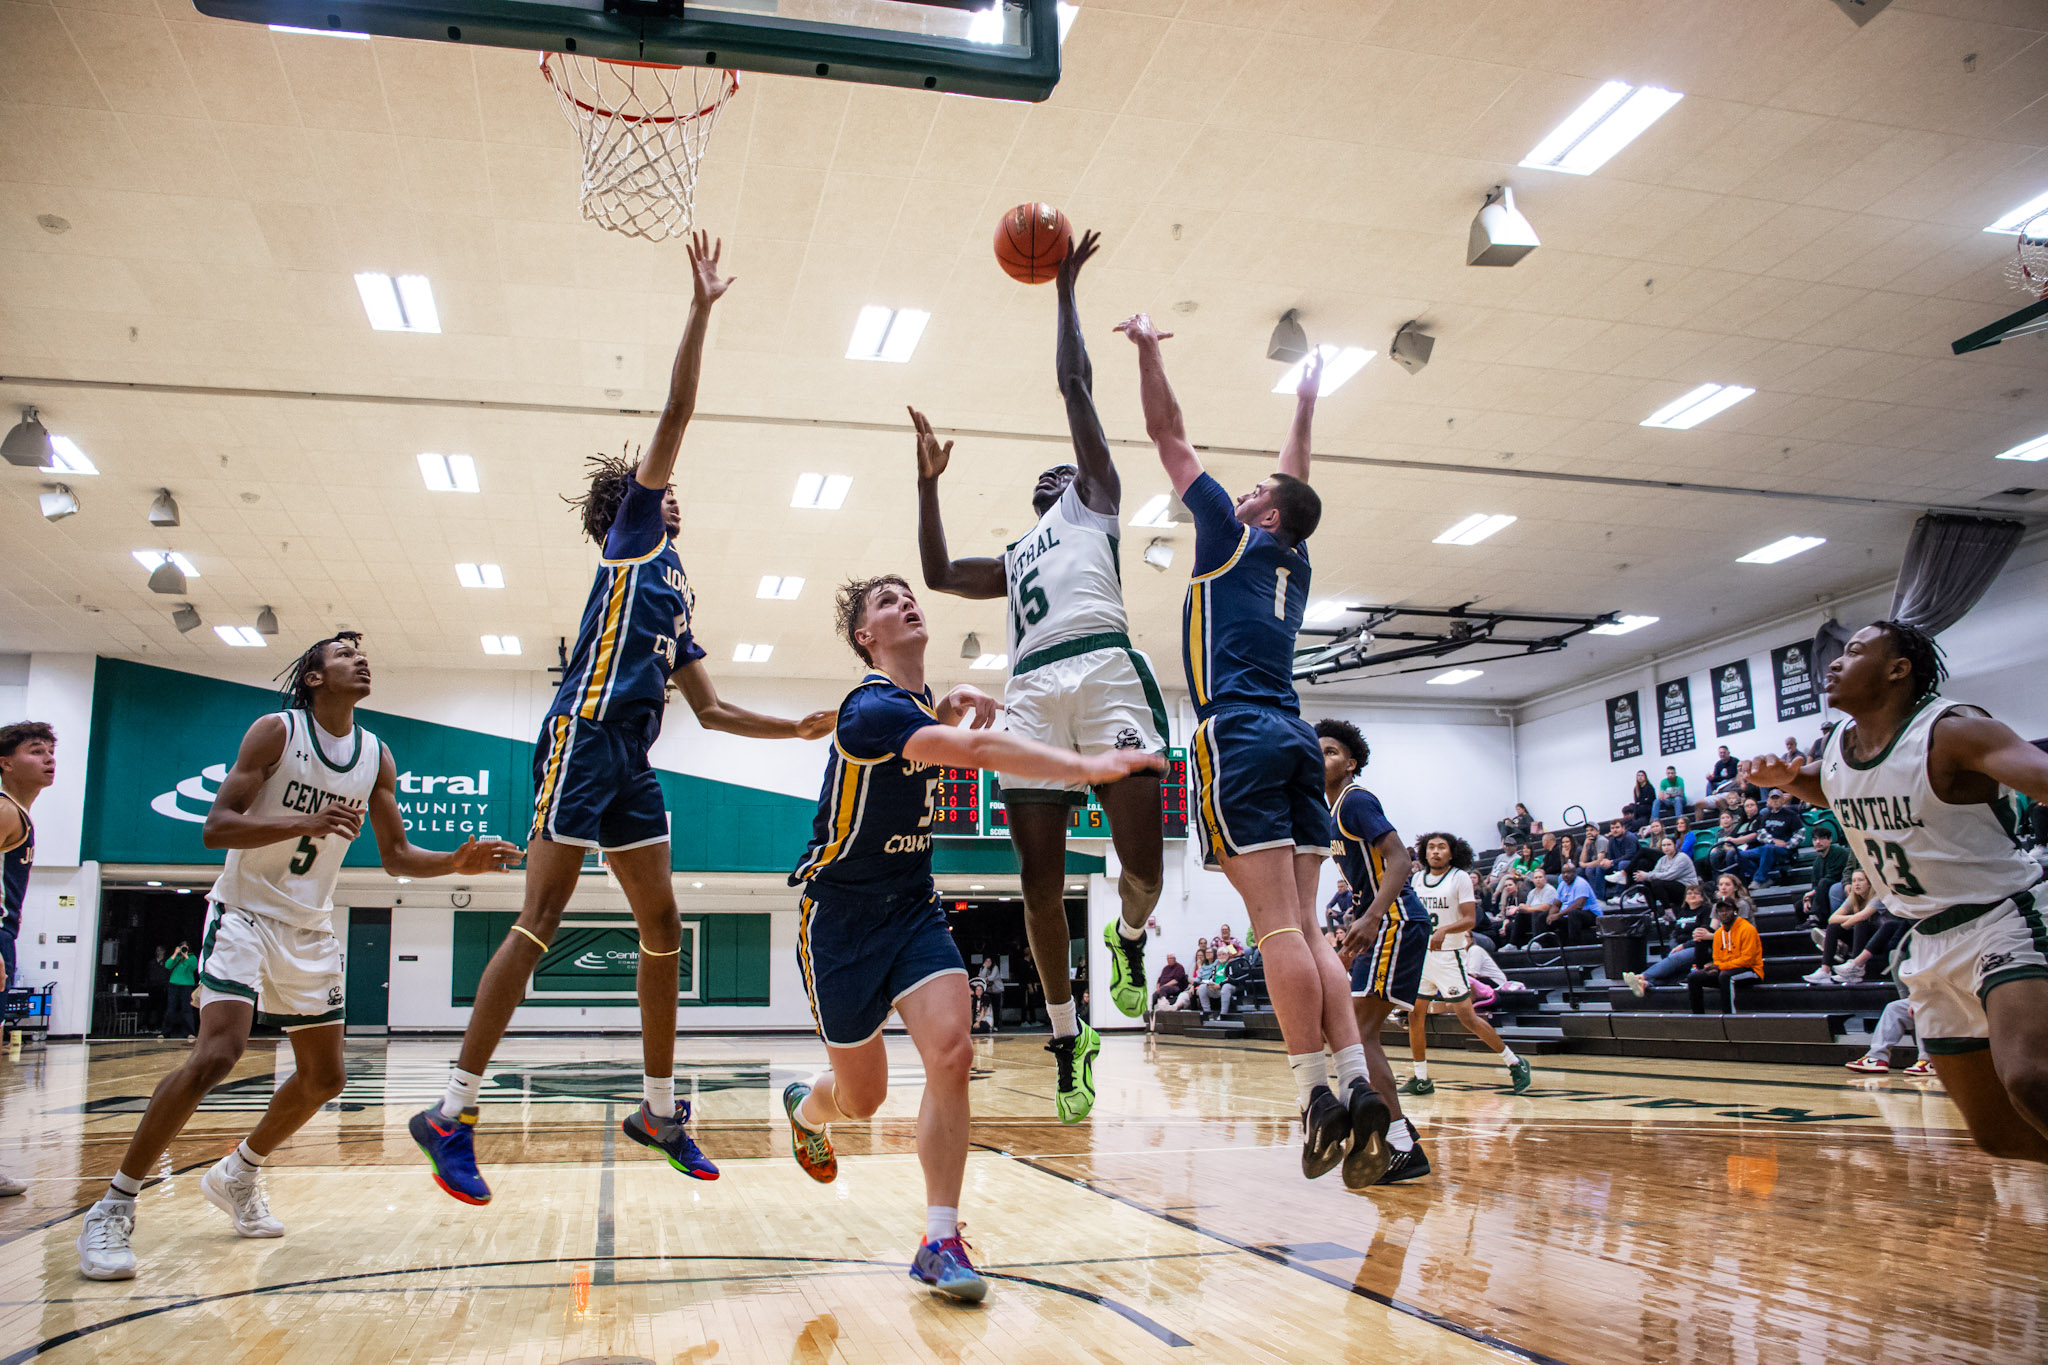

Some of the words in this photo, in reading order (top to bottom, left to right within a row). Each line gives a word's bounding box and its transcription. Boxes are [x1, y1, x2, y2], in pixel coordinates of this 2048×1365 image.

[1274, 566, 1291, 621] 1
[1780, 707, 1796, 717] 1972
[1800, 701, 1817, 712] 1974
[1727, 721, 1743, 731] 2020
[1174, 760, 1186, 773] 13
[949, 768, 957, 780] 0
[965, 770, 978, 780] 14
[396, 770, 489, 795] tral
[938, 782, 945, 794] 5
[969, 783, 978, 795] 2
[397, 802, 488, 815] MUNITY
[949, 796, 957, 808] 0
[969, 796, 978, 808] 0
[949, 809, 957, 822] 0
[969, 809, 978, 822] 0
[1090, 811, 1101, 827] 5
[402, 819, 488, 833] OLLEGE
[884, 831, 933, 854] COUNT
[289, 835, 320, 876] 5
